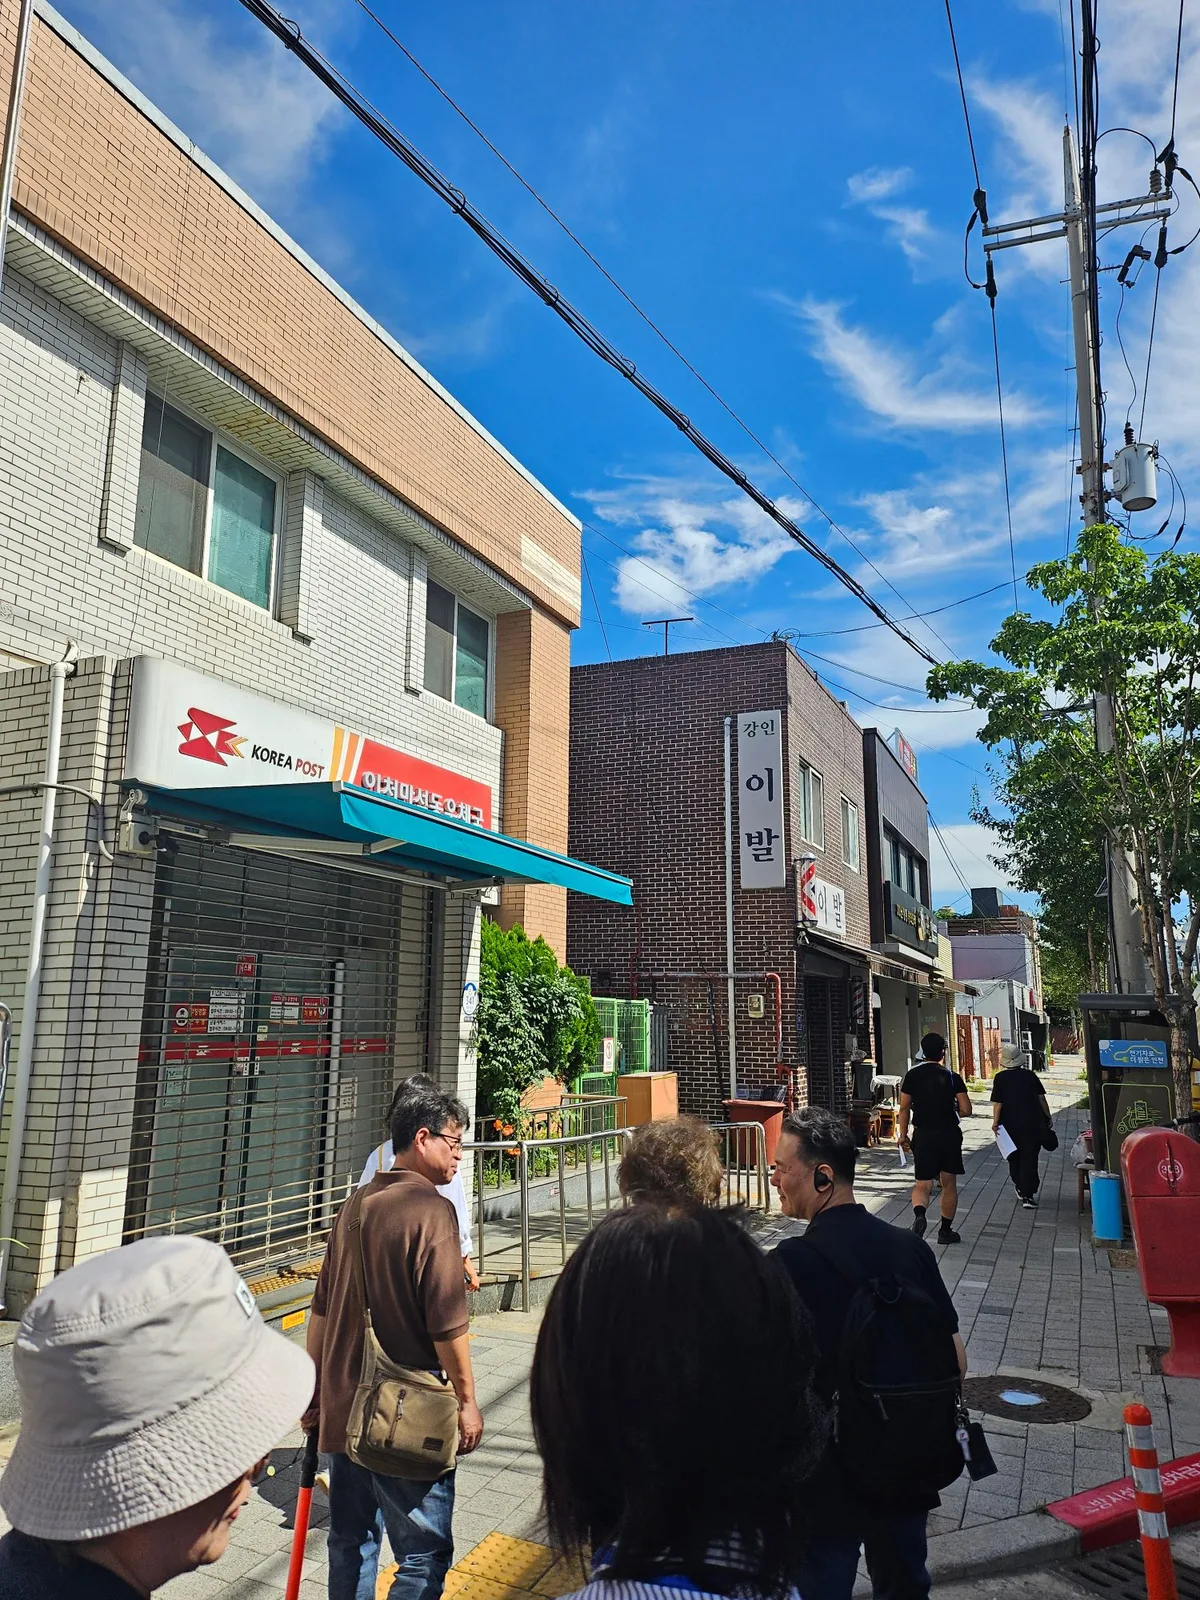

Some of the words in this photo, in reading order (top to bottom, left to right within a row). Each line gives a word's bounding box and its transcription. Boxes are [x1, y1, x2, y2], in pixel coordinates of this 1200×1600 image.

[743, 719, 775, 738] 강인
[251, 744, 293, 771] KOREA
[294, 757, 326, 779] POST
[1129, 1050, 1155, 1058] 전기차로
[1129, 1056, 1137, 1064] 더
